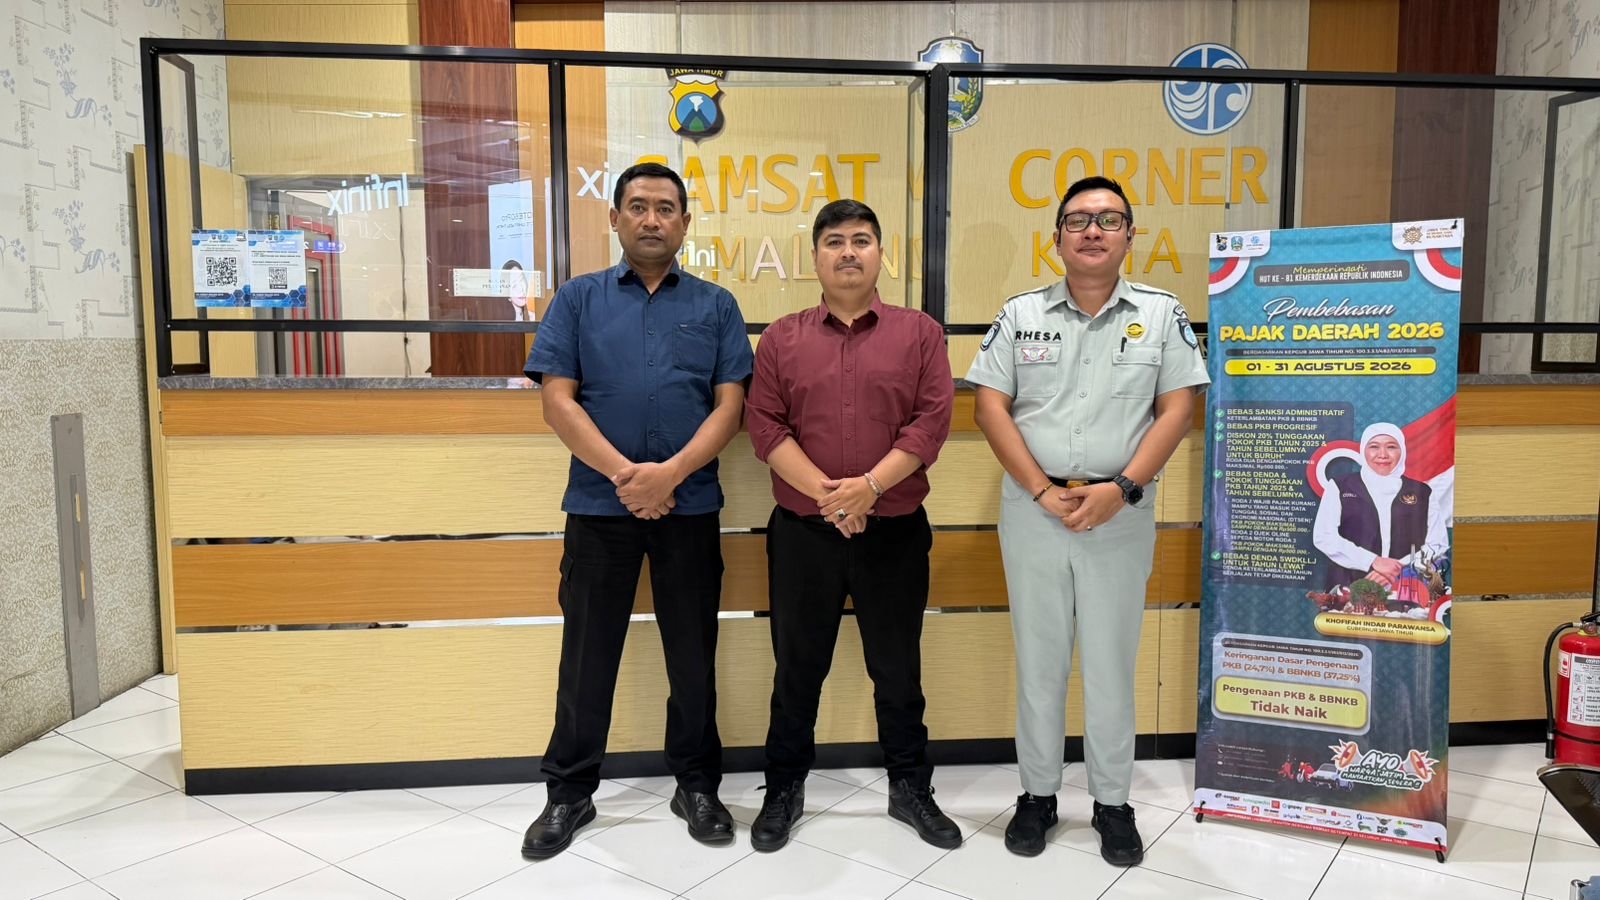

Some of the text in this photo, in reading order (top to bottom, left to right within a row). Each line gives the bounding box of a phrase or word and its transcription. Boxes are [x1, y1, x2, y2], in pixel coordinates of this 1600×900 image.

[636, 153, 881, 213] AMSAT
[1008, 146, 1269, 208] CORNER
[1032, 228, 1183, 277] KTA
[1293, 264, 1366, 274] Memperingati
[1295, 272, 1338, 282] KEMERDEKAAN
[1340, 272, 1368, 280] REPUBLIK
[1370, 270, 1403, 278] INDONESIA
[1263, 297, 1396, 322] Pembebasan
[1015, 330, 1061, 341] RHESA
[1220, 322, 1444, 342] PAJAK DAERAH 2026
[1294, 362, 1364, 371] AGUSTUS
[1370, 361, 1411, 370] 2026
[1325, 618, 1362, 626] KHOFIFAH
[1388, 623, 1436, 632] PARAWANSA
[1223, 662, 1242, 670] PKB
[1287, 668, 1321, 678] BBNKB
[1225, 651, 1359, 672] Keringanan Dasar Pengenaan
[1222, 684, 1358, 706] Pengenaan PKB & BBNKB
[1250, 700, 1328, 719] Tidak Naik
[1362, 752, 1399, 770] AYO
[1380, 771, 1403, 779] JATIM
